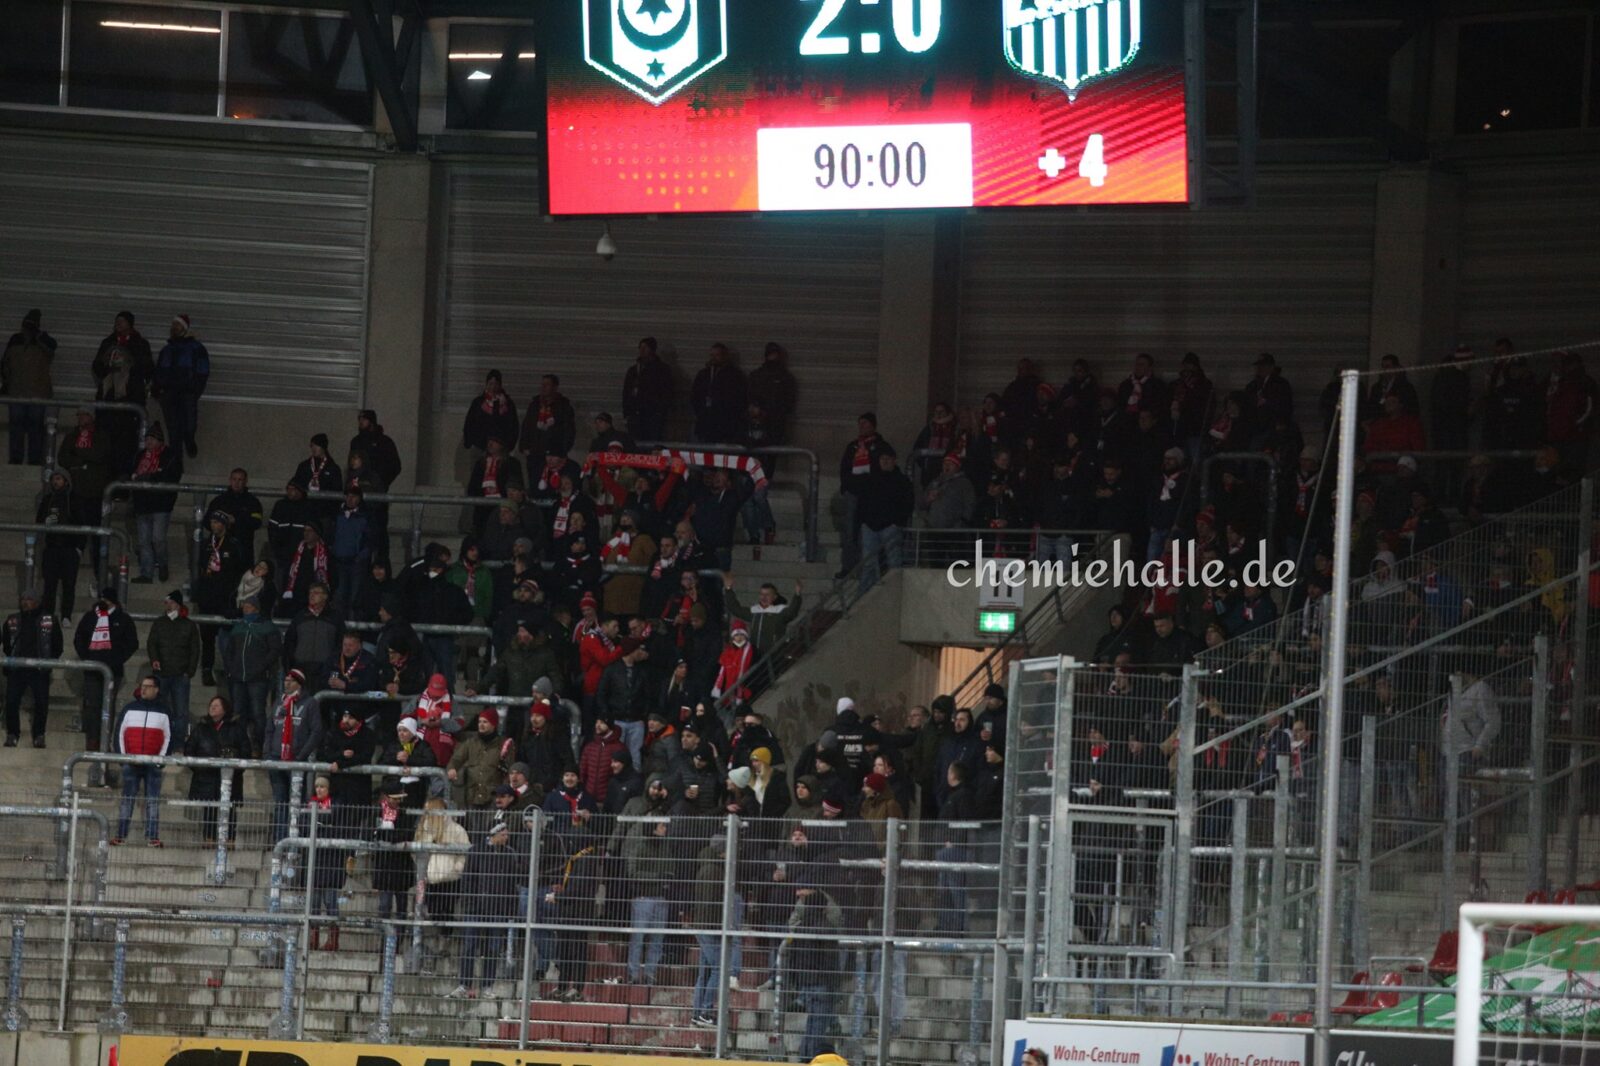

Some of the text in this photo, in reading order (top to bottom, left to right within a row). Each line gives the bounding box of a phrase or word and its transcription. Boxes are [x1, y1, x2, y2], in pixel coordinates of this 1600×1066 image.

[799, 0, 942, 55] 2:0
[814, 141, 926, 187] 90:00
[1053, 1045, 1140, 1064] Wohn-Centrum
